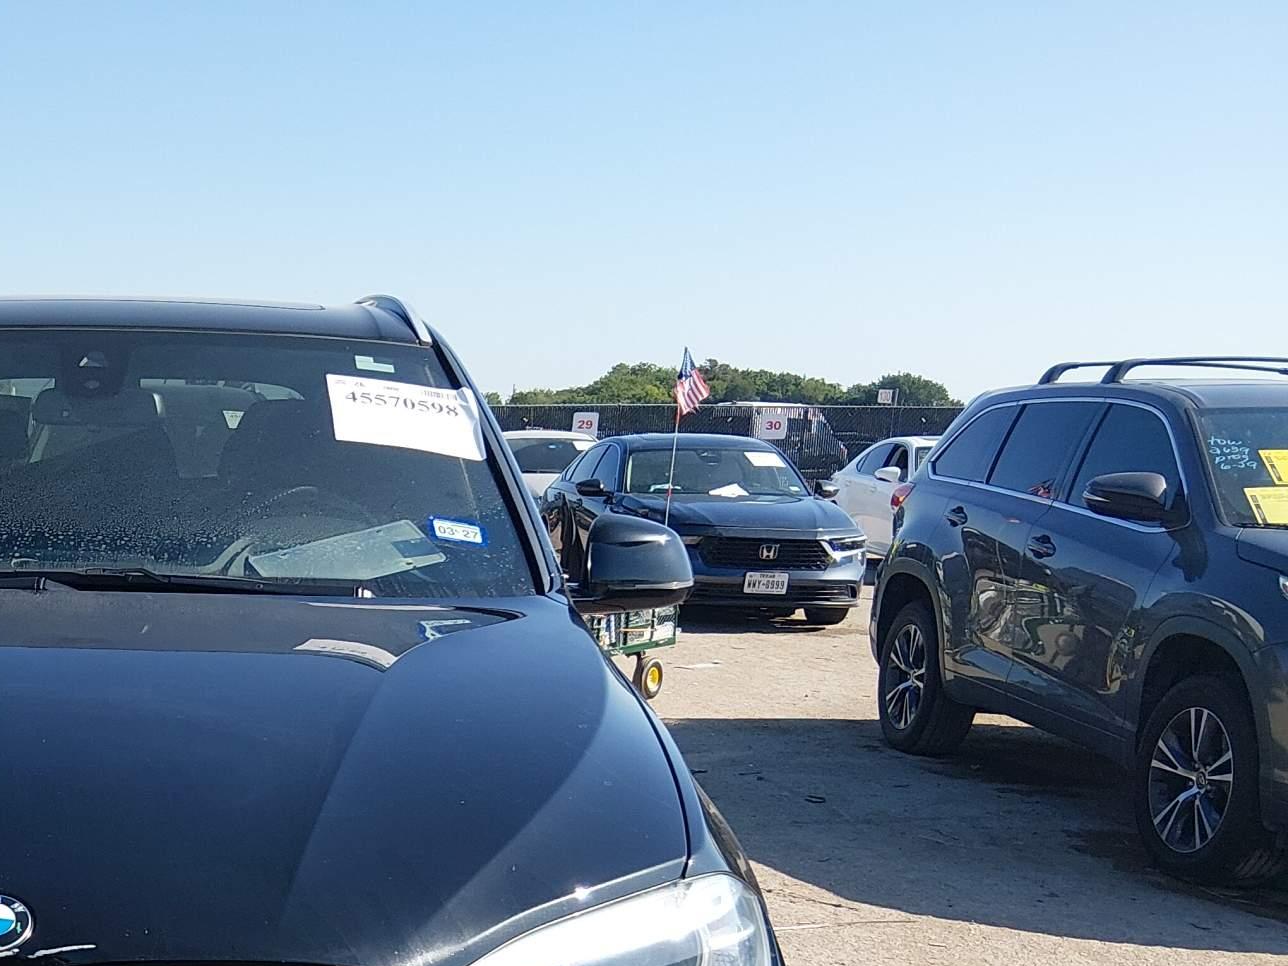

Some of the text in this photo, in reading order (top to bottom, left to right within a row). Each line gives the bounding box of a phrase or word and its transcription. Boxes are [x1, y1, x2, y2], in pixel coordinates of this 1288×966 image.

[345, 390, 460, 418] 45570598
[577, 419, 593, 430] 29
[765, 420, 782, 431] 30
